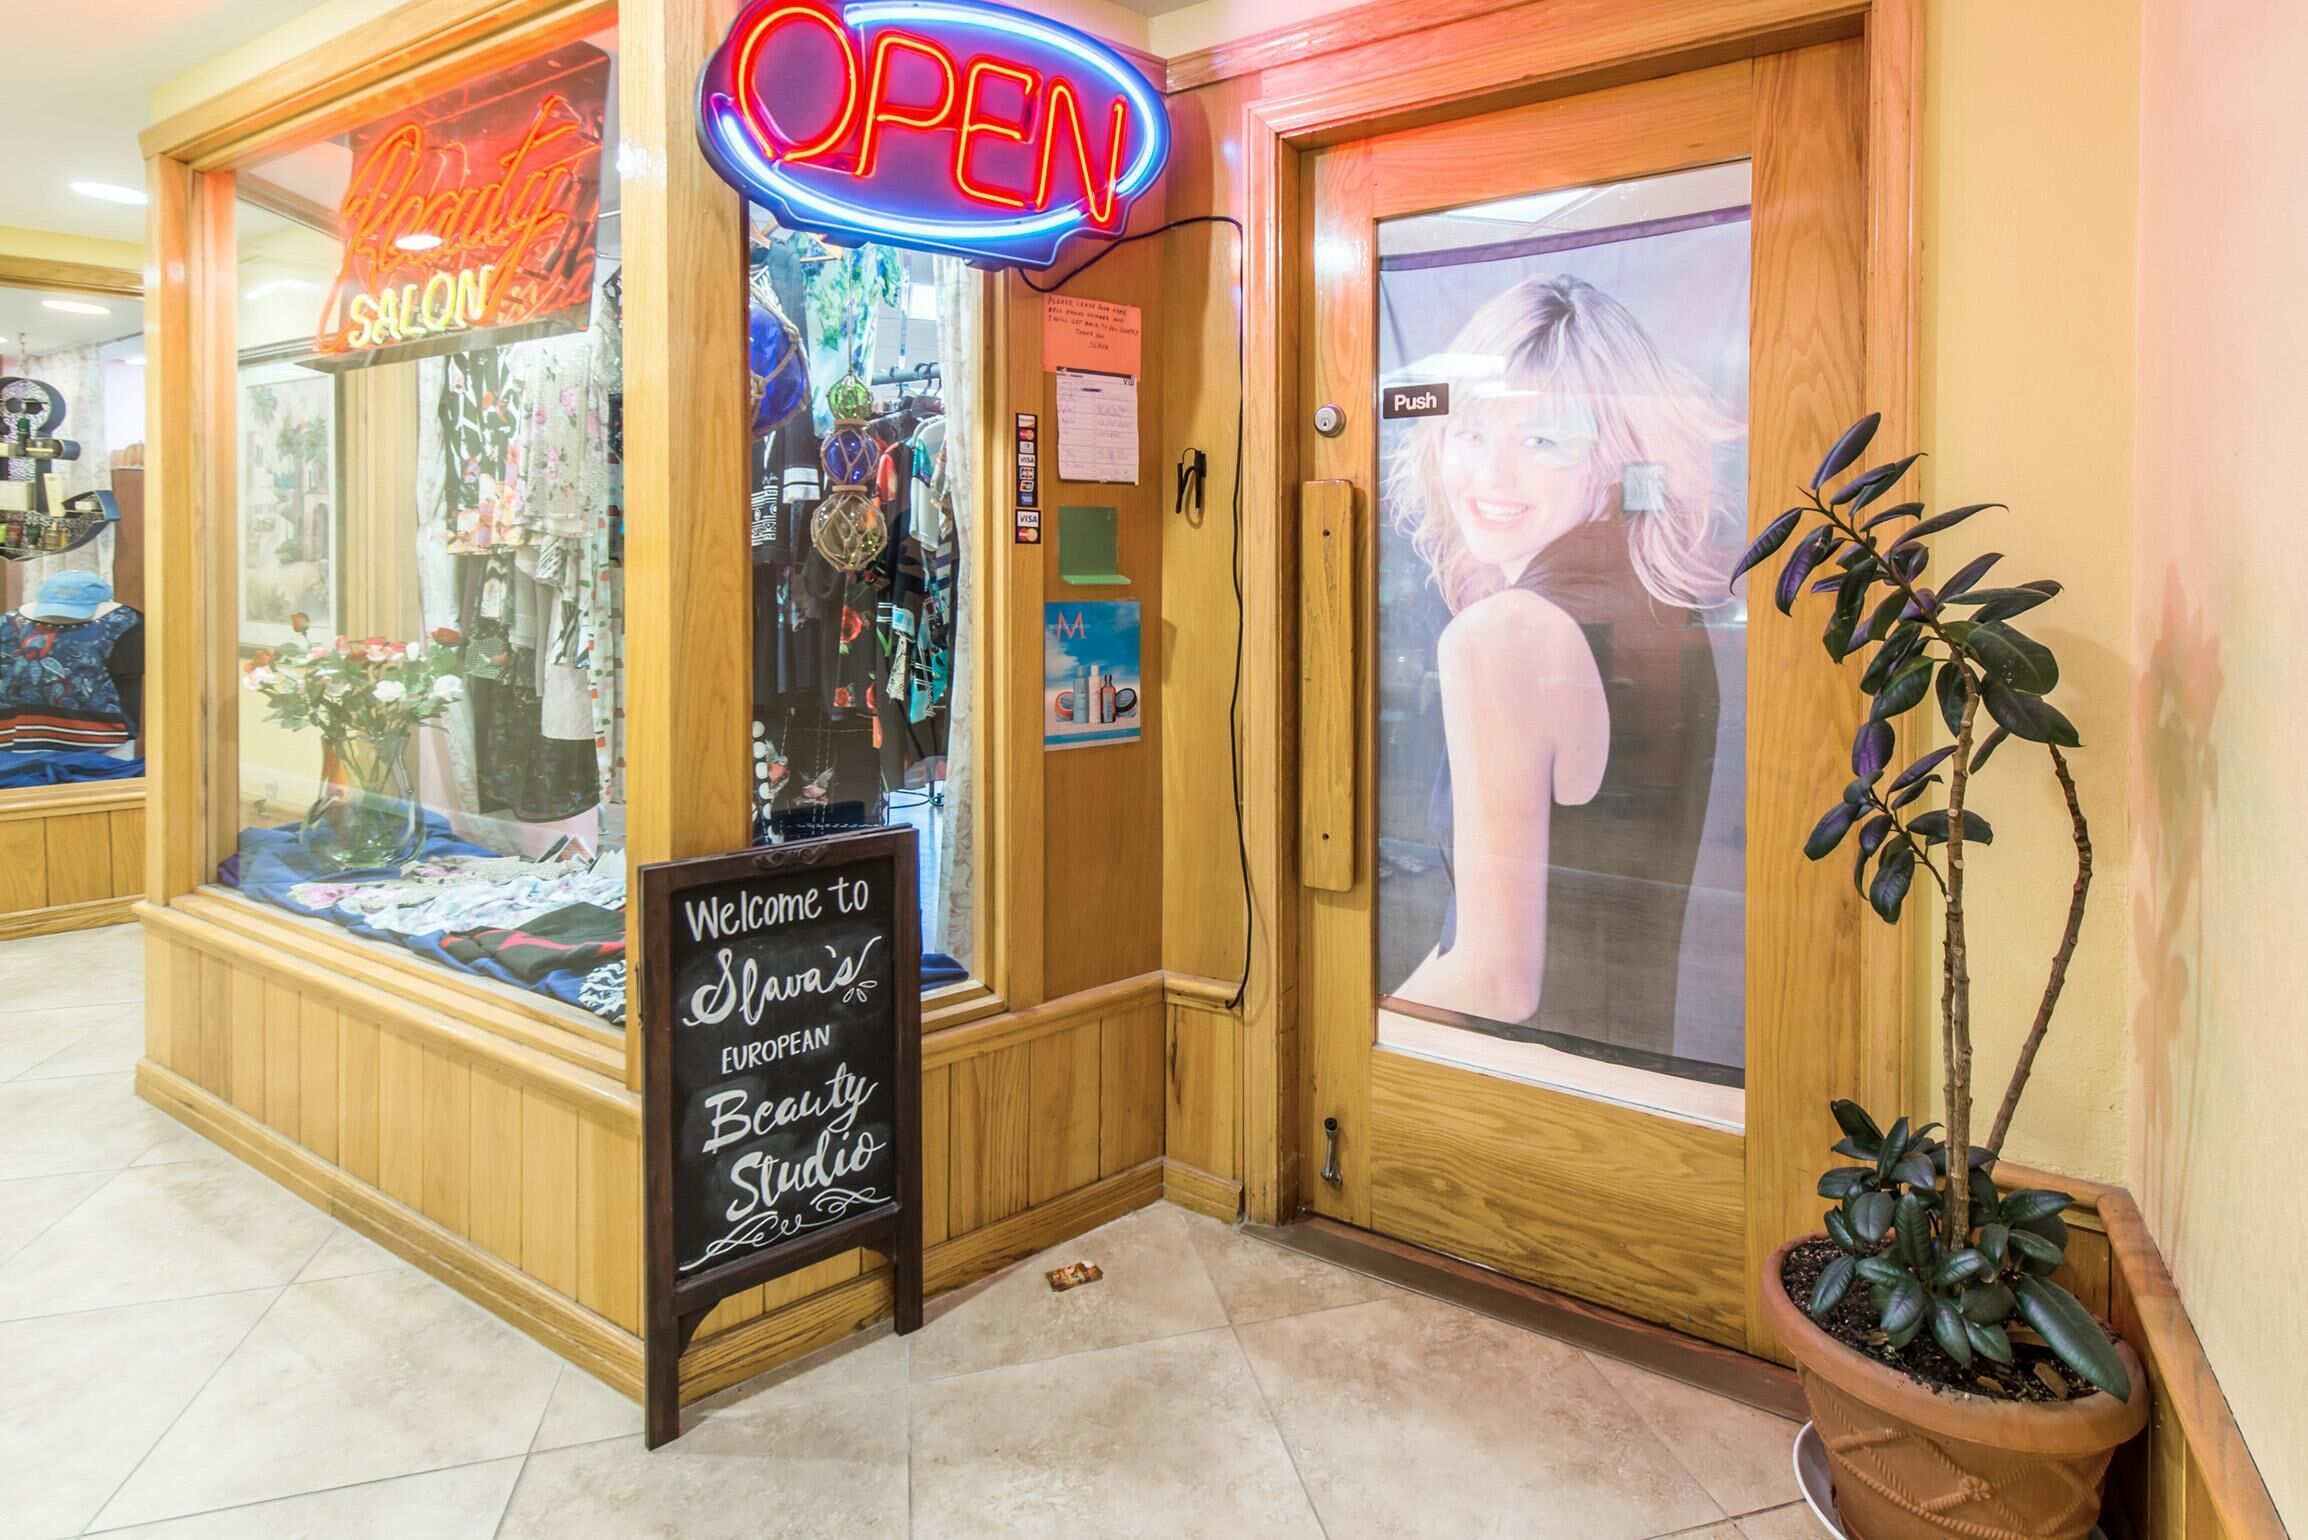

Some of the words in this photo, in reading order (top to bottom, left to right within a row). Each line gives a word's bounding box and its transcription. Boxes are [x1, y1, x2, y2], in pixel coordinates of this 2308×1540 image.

[732, 0, 1128, 228] OPEN
[330, 95, 580, 335] Beauty
[349, 265, 497, 347] SALON
[1394, 392, 1437, 411] Push
[1020, 515, 1038, 523] VISA
[684, 886, 822, 943] Welcome
[827, 876, 869, 911] to
[682, 935, 882, 1027] Slava's
[721, 1024, 831, 1075] EUROPEAN
[702, 1061, 879, 1155] Beauty
[726, 1128, 887, 1223] Studio
